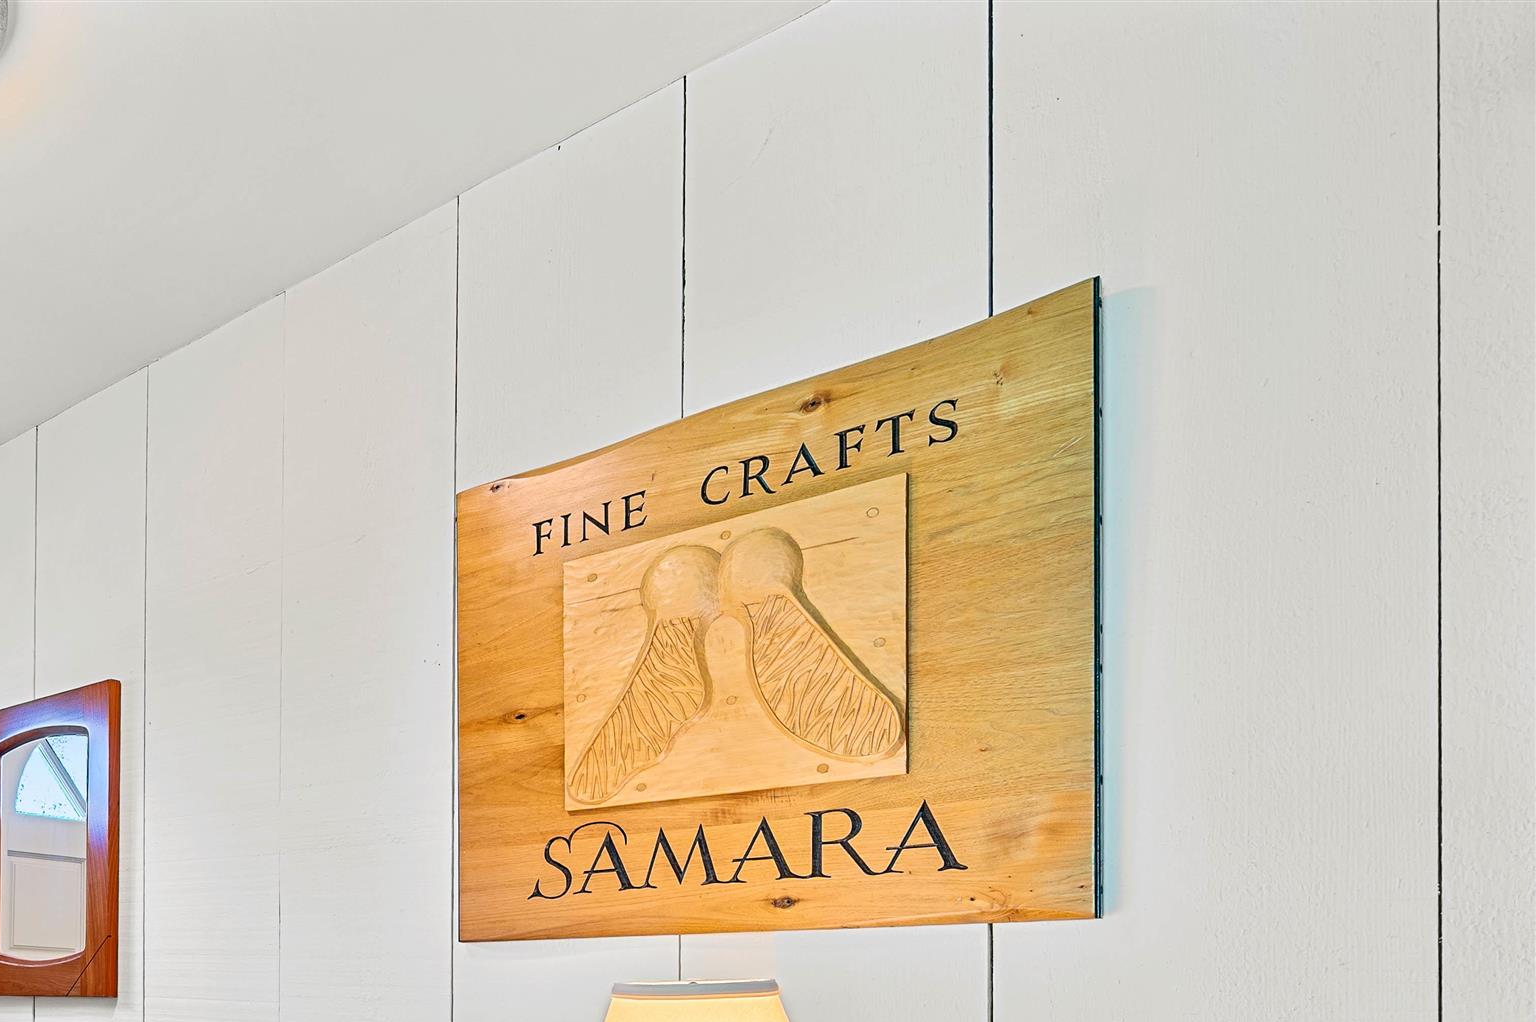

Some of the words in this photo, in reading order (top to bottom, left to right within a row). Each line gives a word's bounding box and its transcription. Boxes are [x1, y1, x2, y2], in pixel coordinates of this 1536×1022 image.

[531, 490, 648, 556] FINE
[701, 399, 960, 505] CRAFTS
[527, 800, 969, 900] SAMARA
